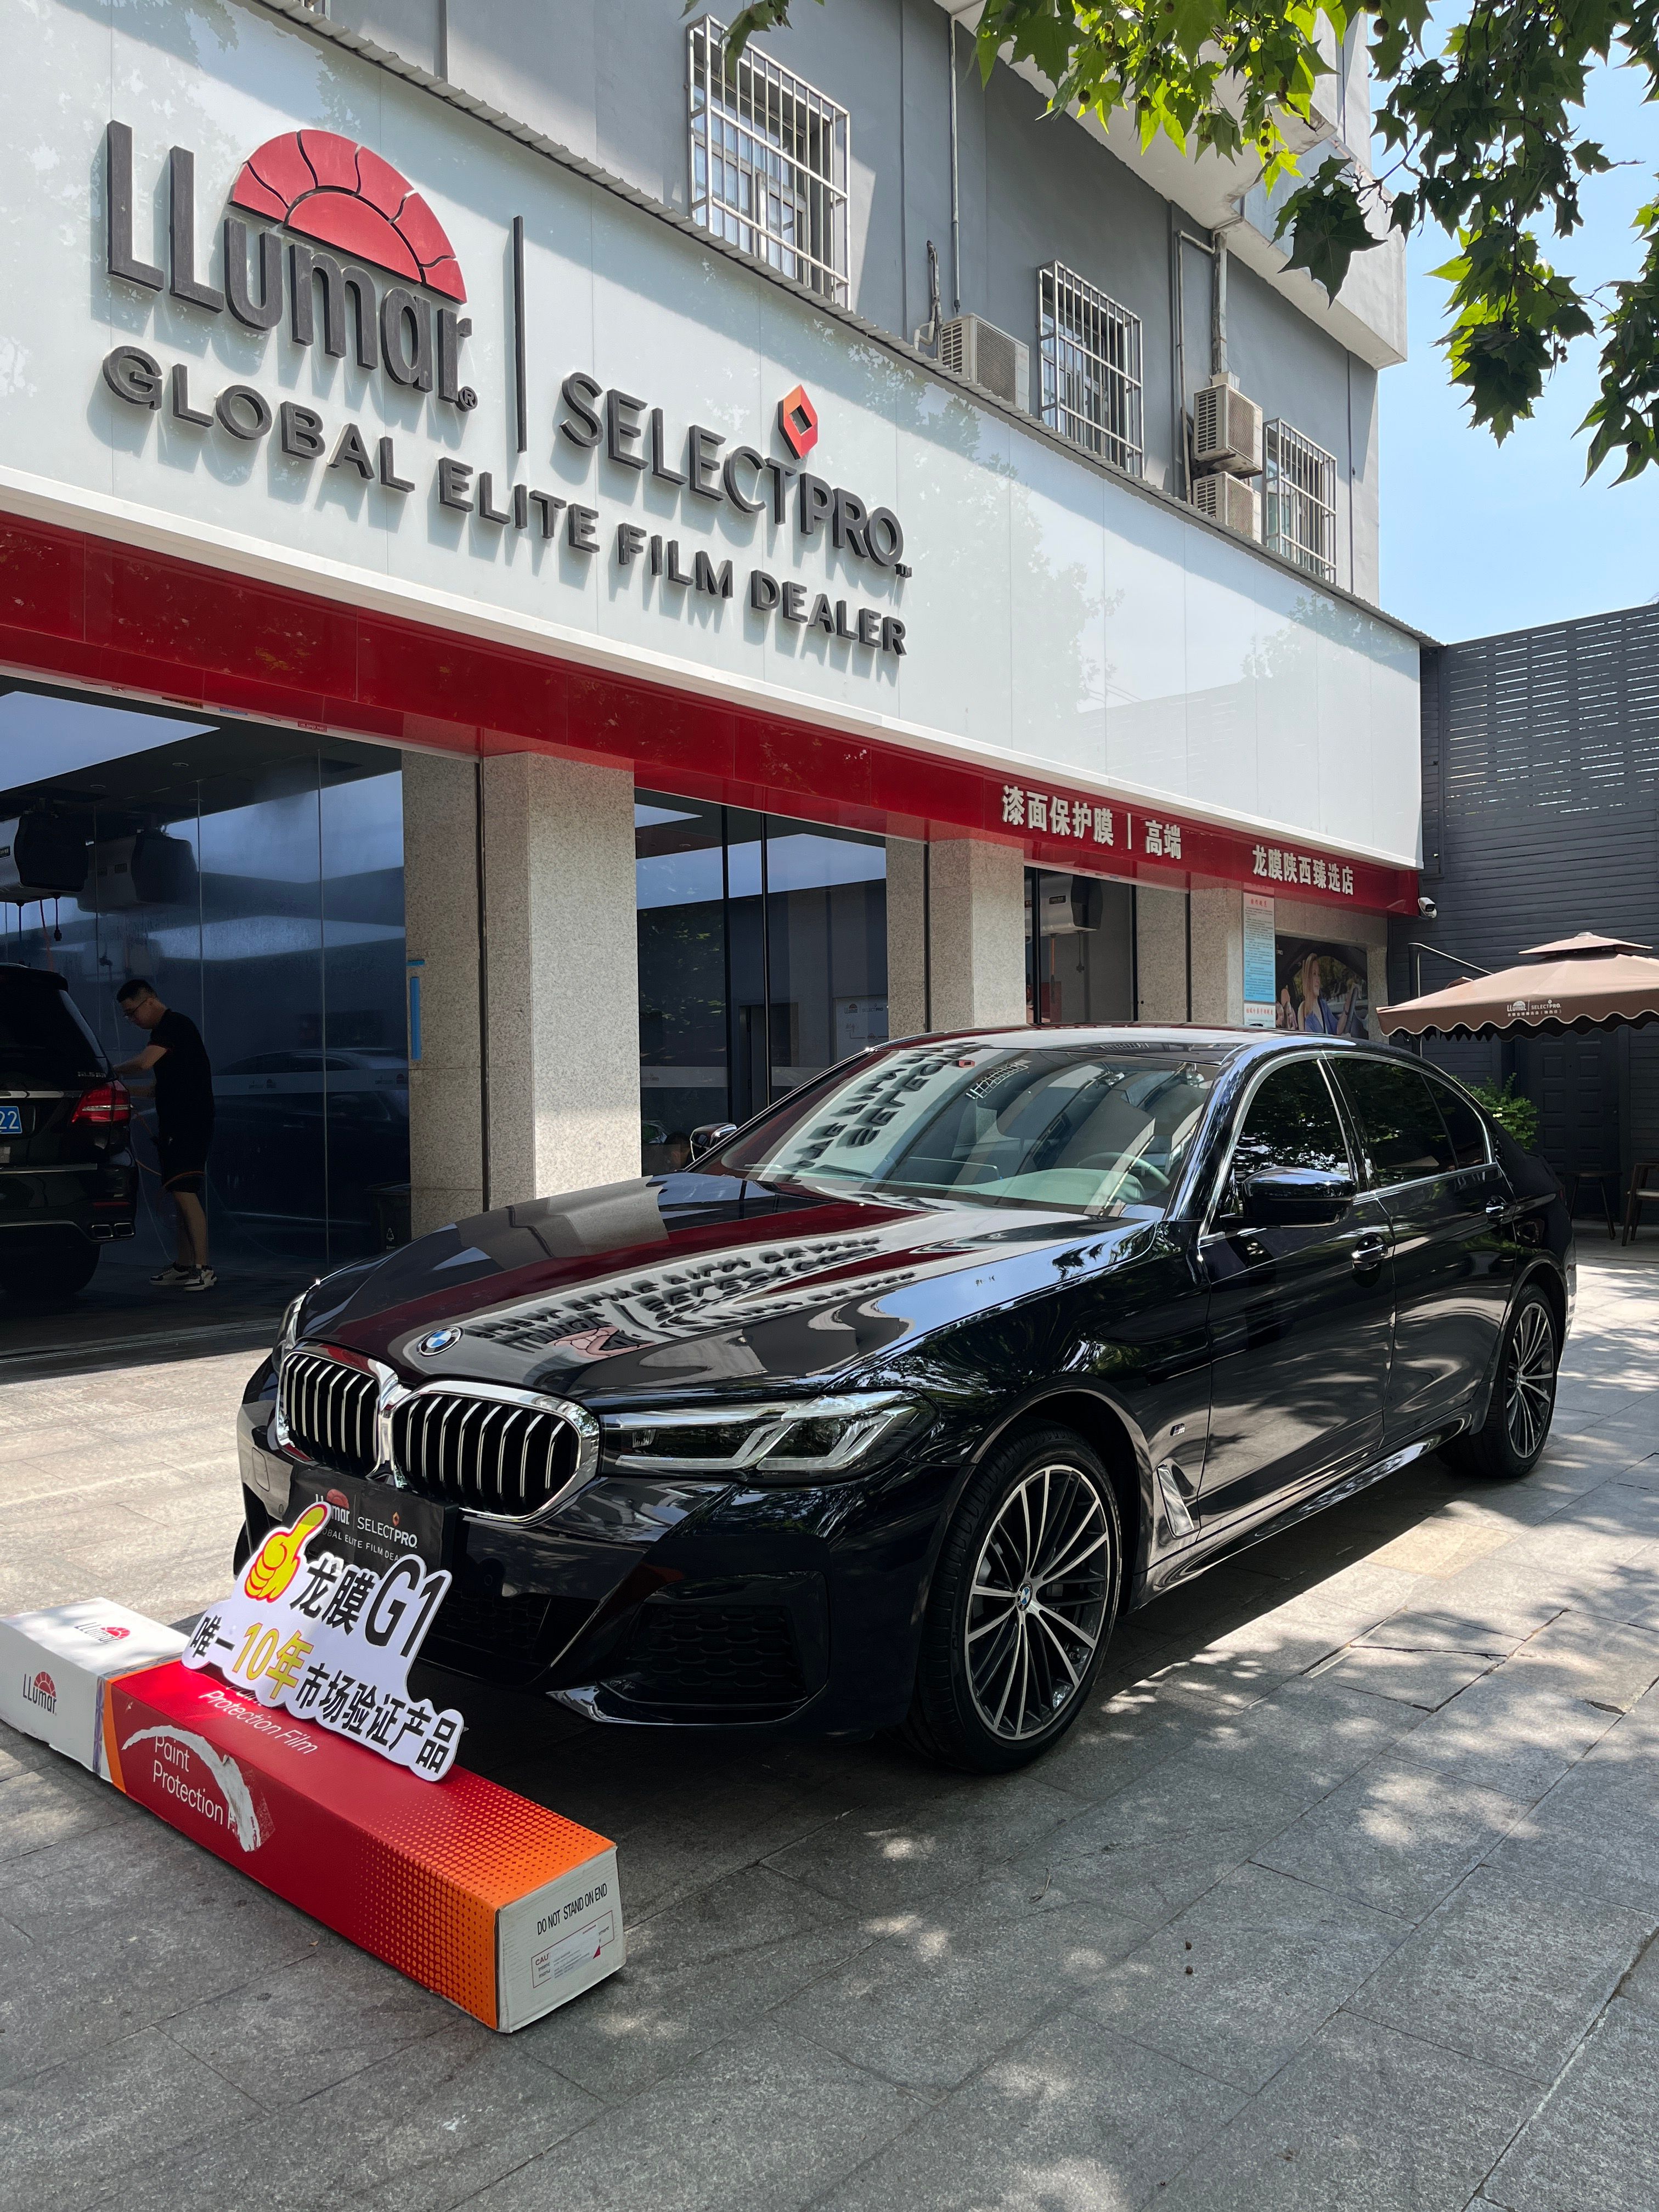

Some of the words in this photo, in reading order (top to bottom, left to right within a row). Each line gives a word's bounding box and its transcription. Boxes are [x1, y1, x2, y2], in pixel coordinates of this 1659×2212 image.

[103, 345, 415, 493] GLOBAL
[438, 457, 600, 554] ELITE
[618, 522, 733, 599] FILM
[751, 568, 907, 656] DEALER
[1002, 785, 1114, 847] 漆面保护膜
[1145, 820, 1182, 860] 高端
[1252, 844, 1354, 895] 龙膜陕西臻选店
[322, 1527, 342, 1540] OBAL
[345, 1534, 363, 1548] ELITE
[366, 1543, 383, 1556] FILM
[385, 1550, 401, 1561] DEA
[23, 1673, 57, 1714] LLumar
[199, 1690, 281, 1735] Protection
[274, 1729, 318, 1754] Film
[155, 1736, 190, 1773] Paint
[153, 1759, 223, 1825] Protection
[537, 1918, 547, 1936] DO
[548, 1909, 561, 1929] NOT
[563, 1896, 584, 1920] STAND
[585, 1891, 594, 1908] ON
[595, 1883, 607, 1903] END
